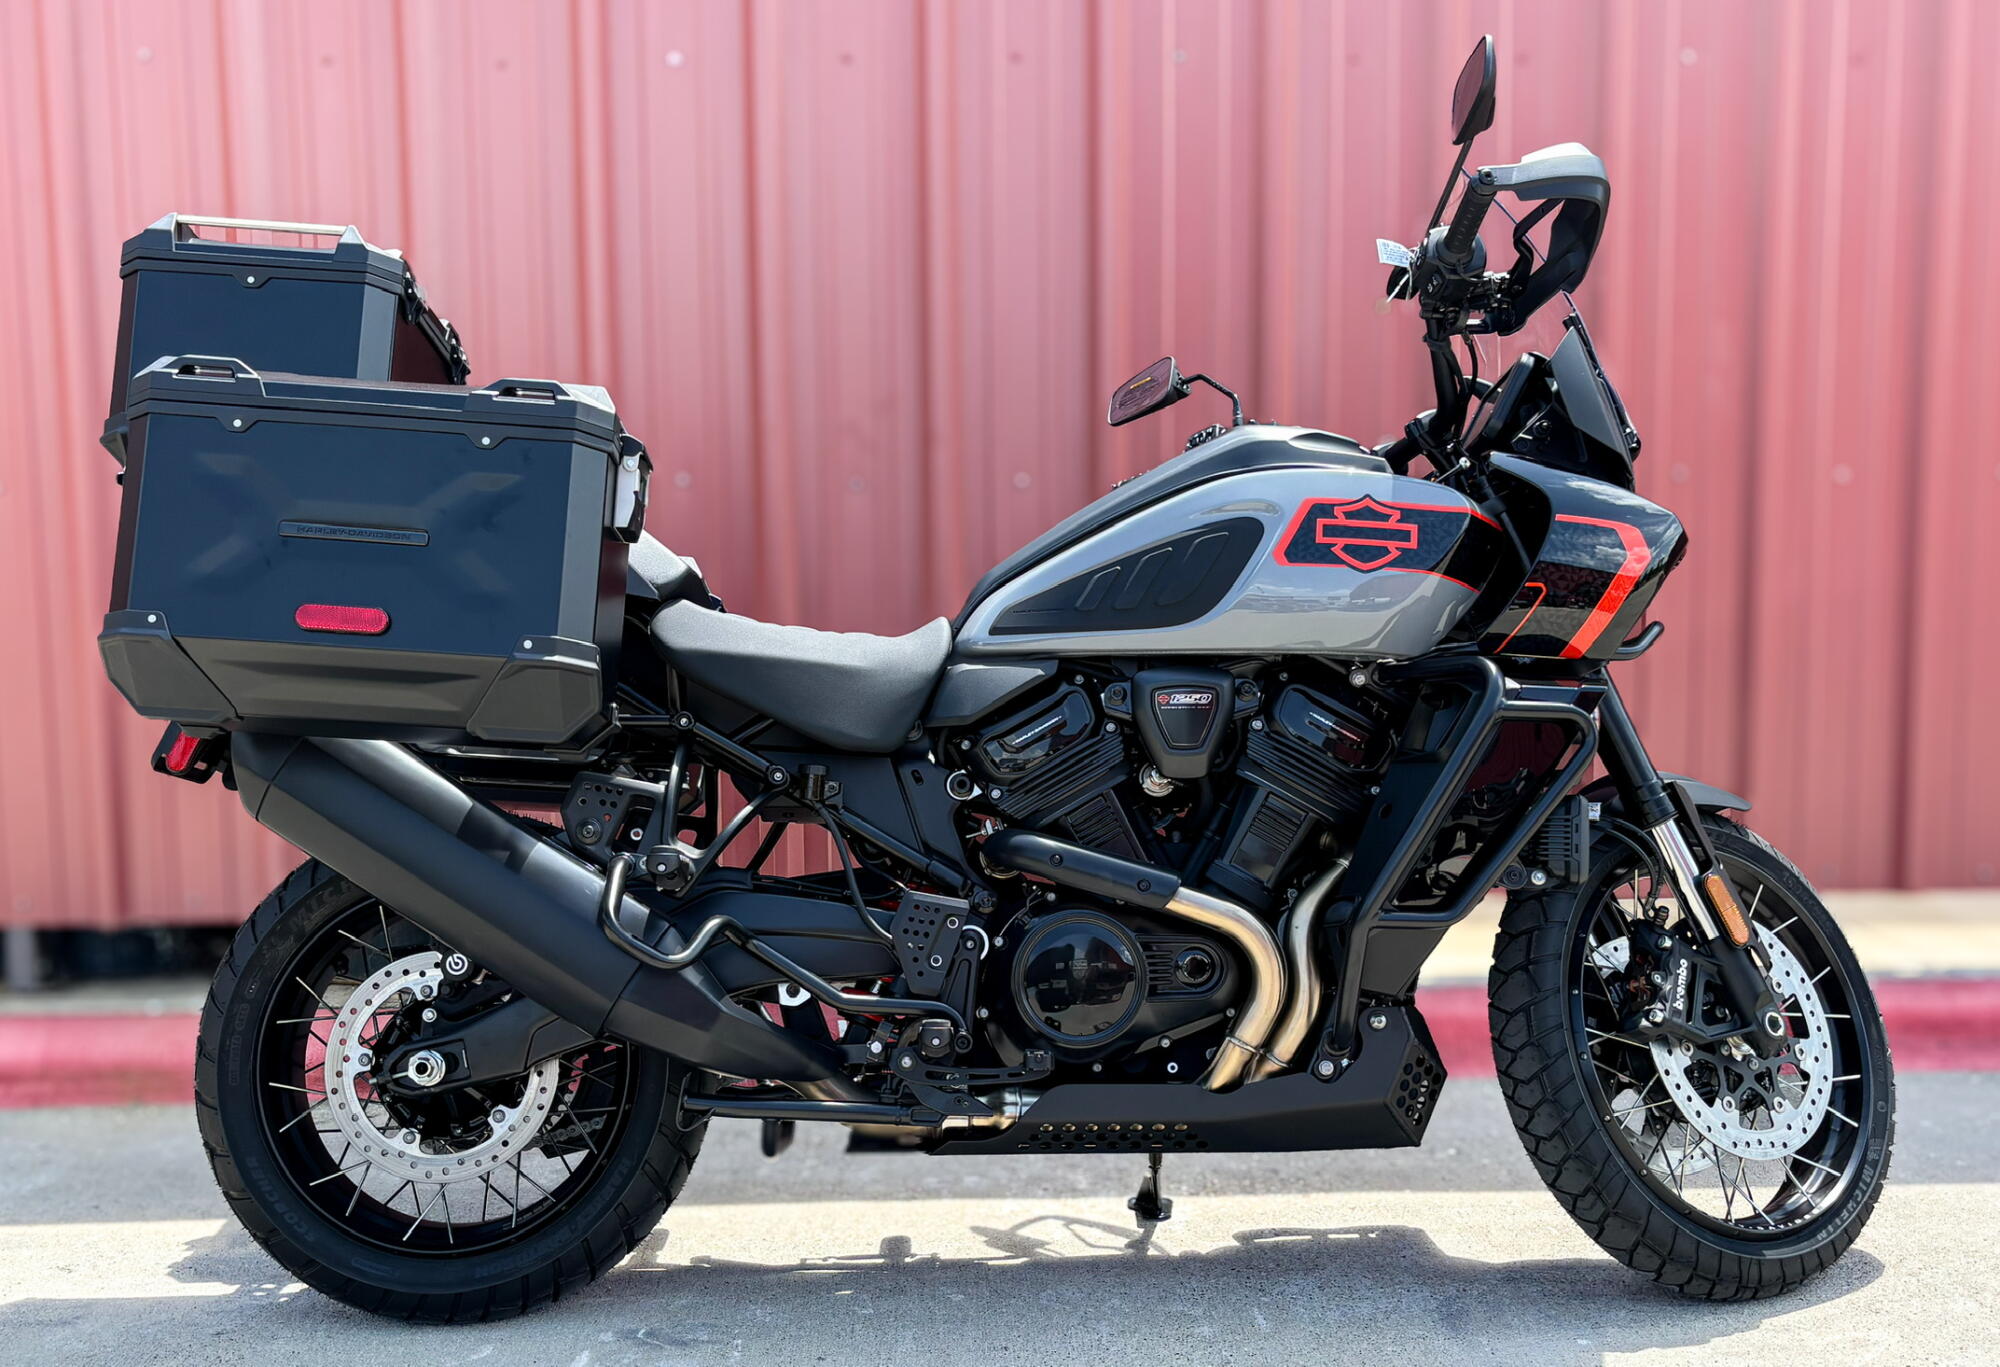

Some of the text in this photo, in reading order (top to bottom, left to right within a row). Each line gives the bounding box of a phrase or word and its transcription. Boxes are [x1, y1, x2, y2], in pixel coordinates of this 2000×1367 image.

[1169, 693, 1213, 705] 1250
[1672, 958, 1688, 1010] brembo
[1816, 1164, 1875, 1241] MICHELIN
